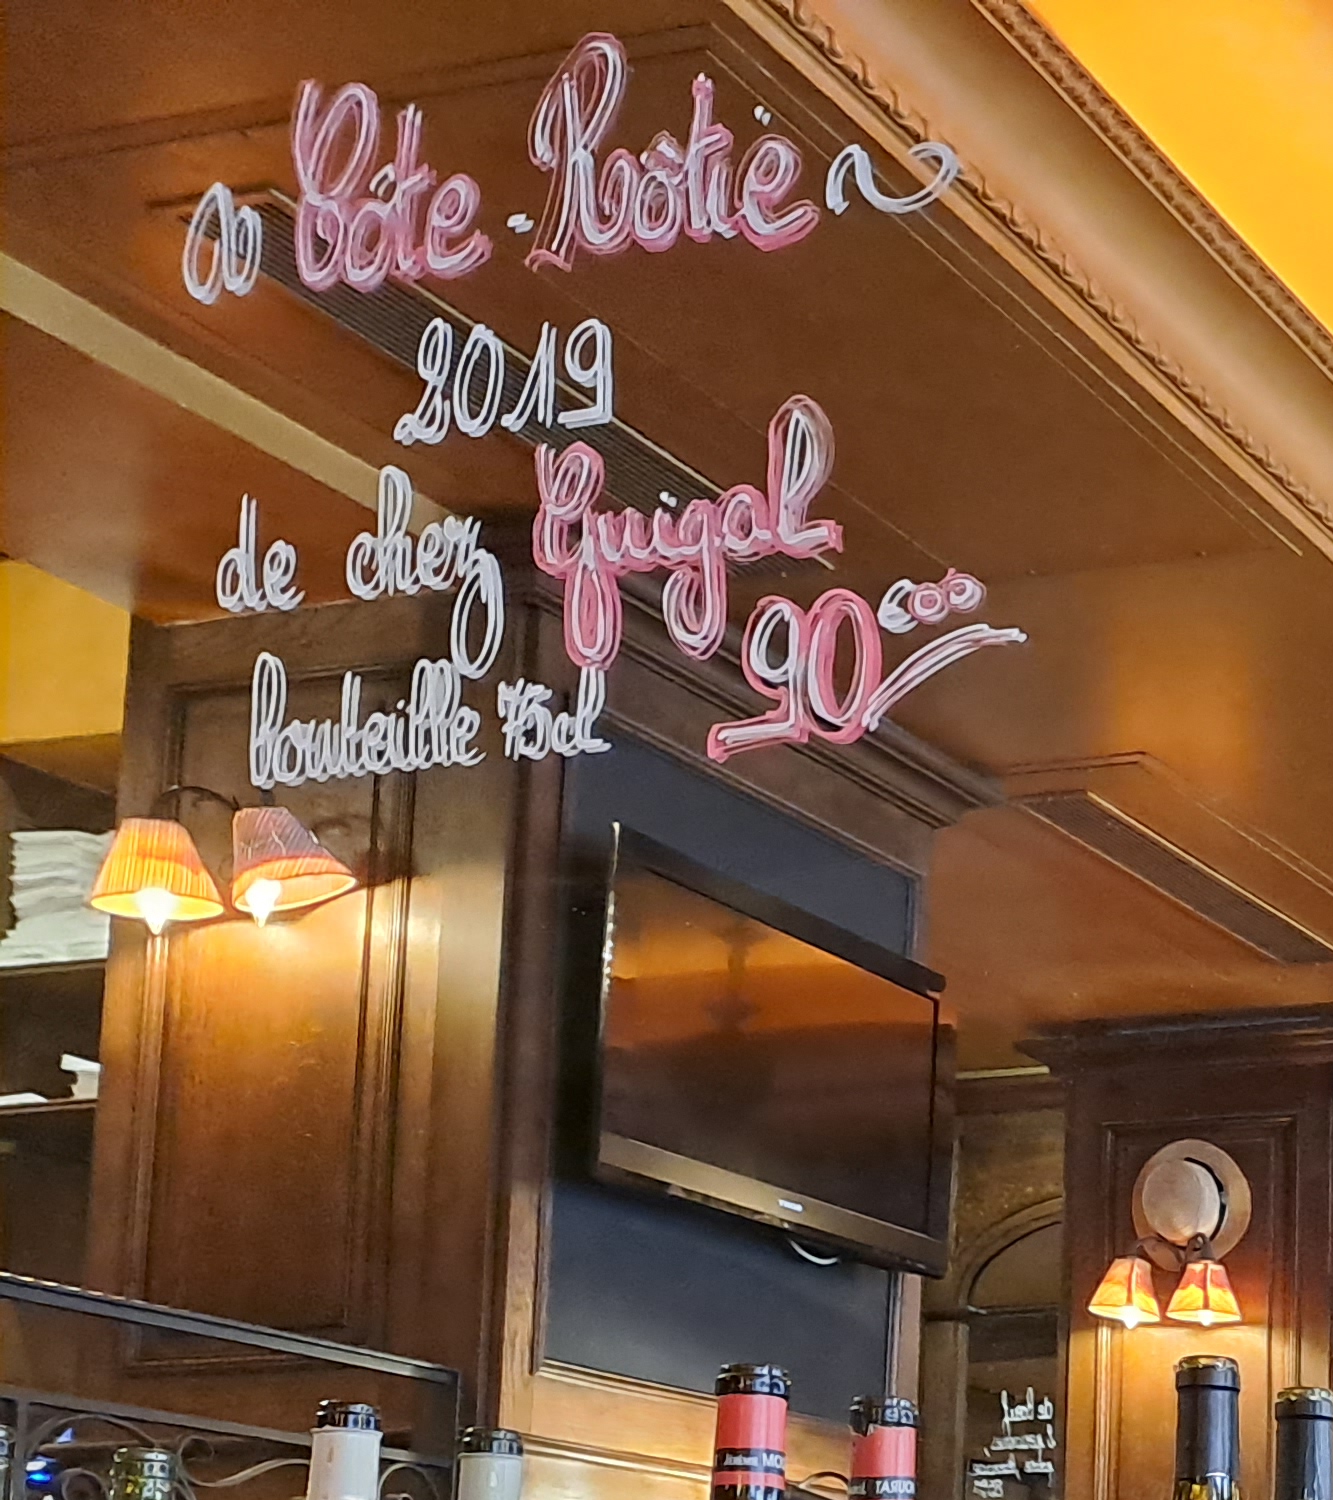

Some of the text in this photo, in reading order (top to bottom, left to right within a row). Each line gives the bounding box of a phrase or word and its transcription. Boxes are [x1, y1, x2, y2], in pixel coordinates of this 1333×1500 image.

[394, 317, 614, 446] 2019
[216, 394, 844, 680] de chez Guigal
[249, 651, 488, 790] bouteille
